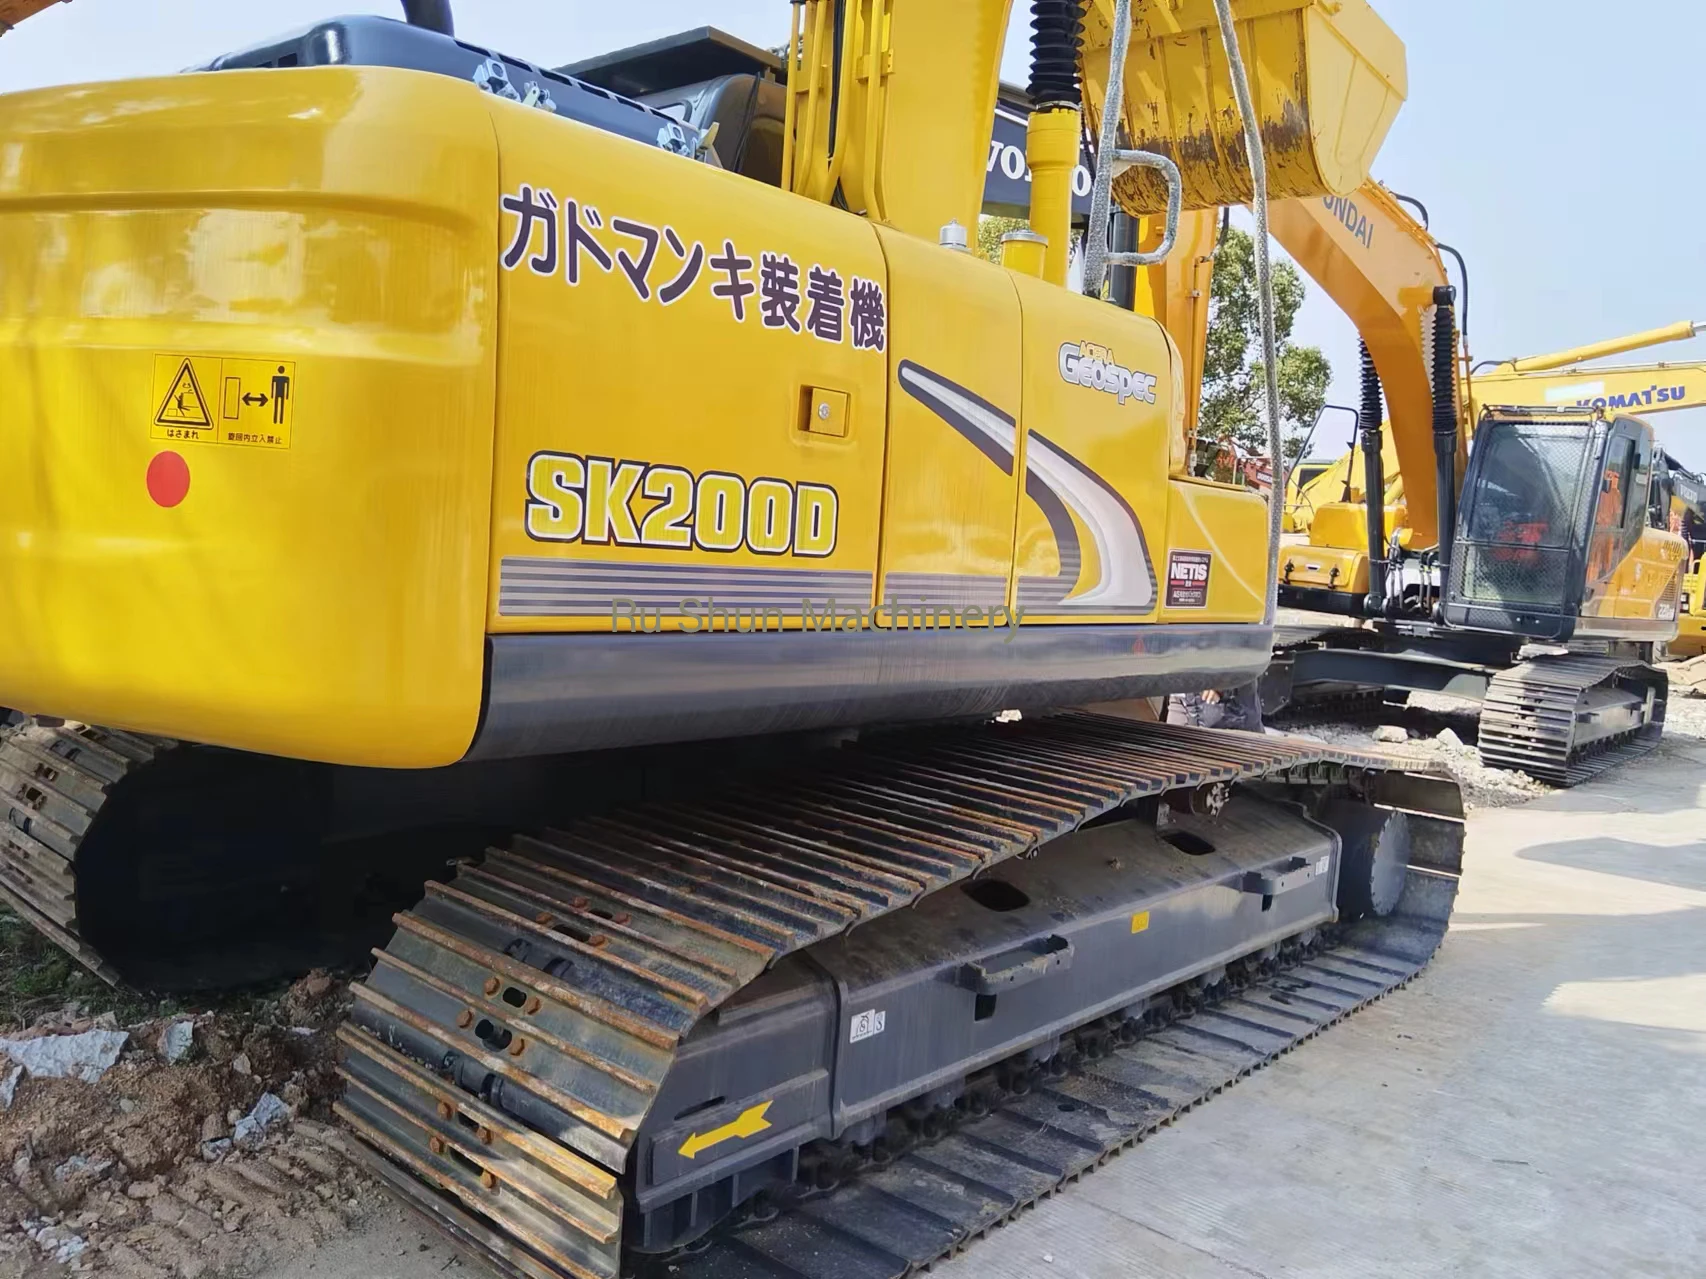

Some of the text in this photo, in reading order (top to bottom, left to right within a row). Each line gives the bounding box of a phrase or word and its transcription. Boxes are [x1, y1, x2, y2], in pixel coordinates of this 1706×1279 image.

[501, 183, 887, 353] ガドマンキ装着機
[166, 429, 200, 440] はさまれ
[525, 450, 839, 558] SK200D
[1170, 562, 1208, 581] NETIS
